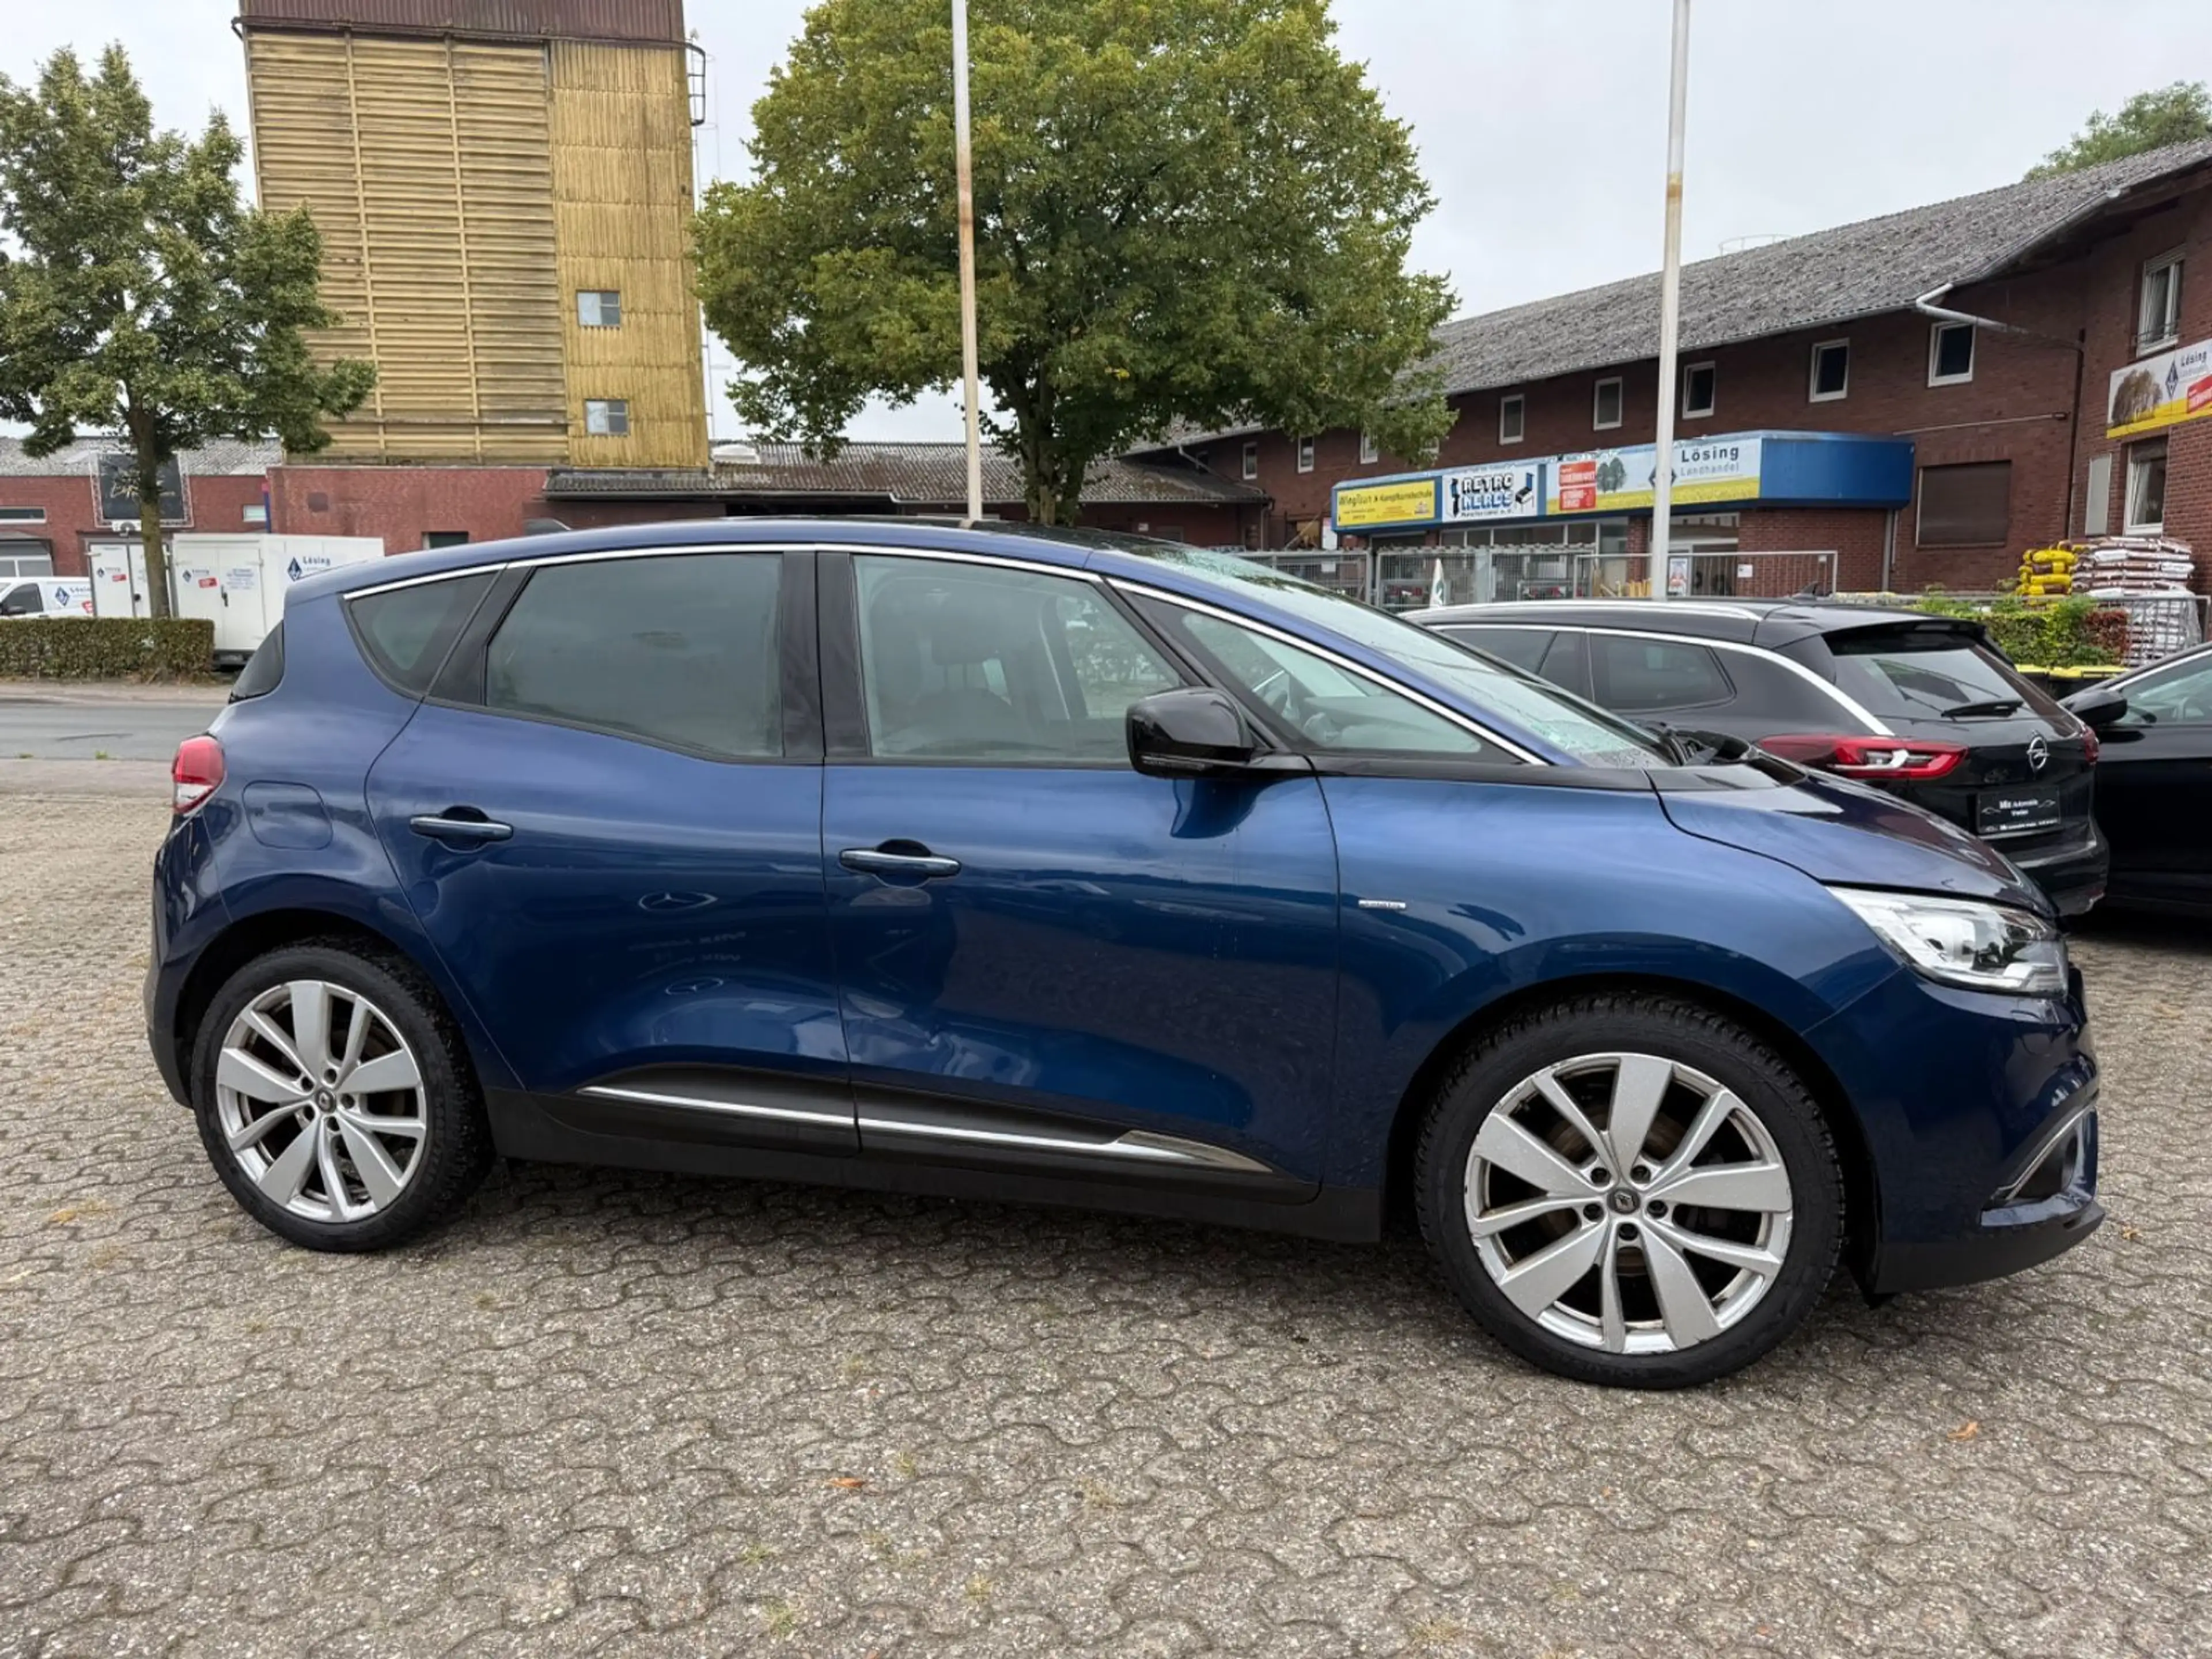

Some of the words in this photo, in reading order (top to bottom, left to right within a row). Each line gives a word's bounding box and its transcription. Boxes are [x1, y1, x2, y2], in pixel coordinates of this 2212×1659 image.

[1681, 446, 1740, 463] Lösing
[1680, 463, 1740, 476] Landhandel
[1461, 472, 1514, 494] RETRO
[1461, 490, 1513, 511] NERDS
